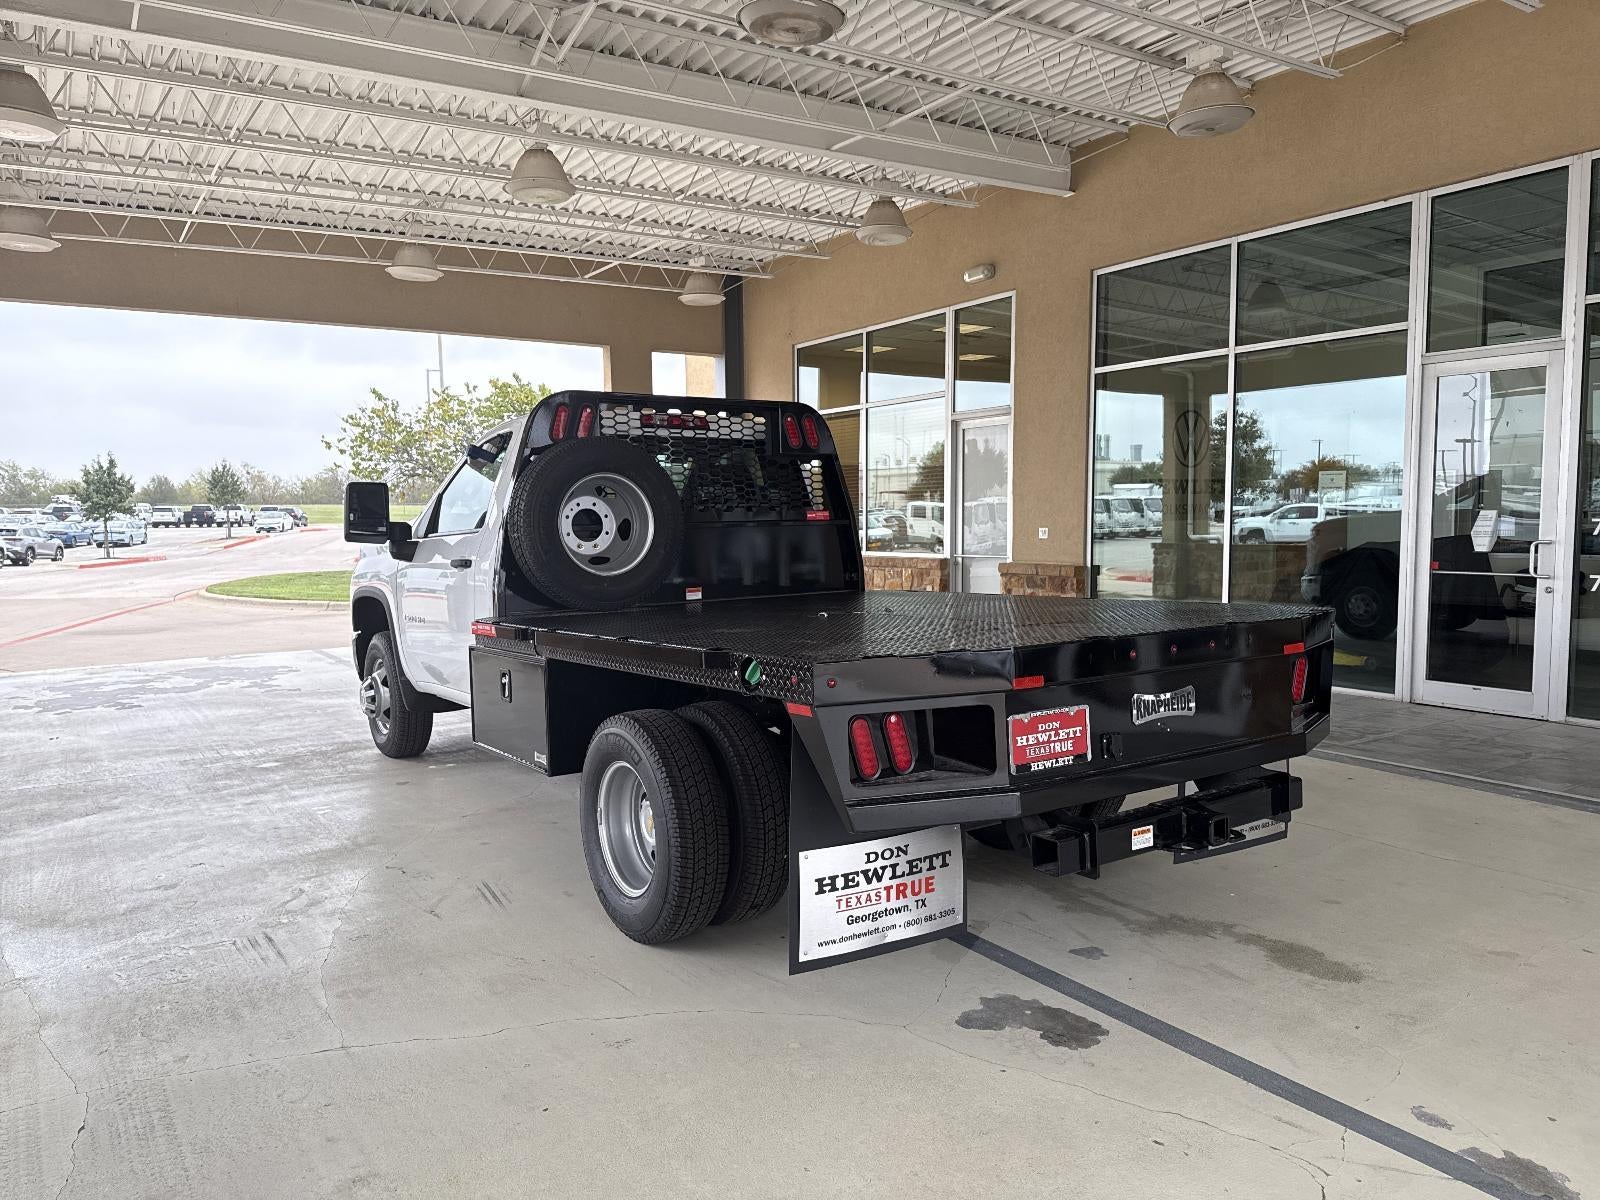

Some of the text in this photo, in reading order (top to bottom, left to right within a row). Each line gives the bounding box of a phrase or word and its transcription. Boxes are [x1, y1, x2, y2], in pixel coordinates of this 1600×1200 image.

[1135, 690, 1193, 720] KNAPHEIDE
[1015, 727, 1083, 747] HEWLETT
[1037, 721, 1061, 732] DON
[1030, 755, 1074, 772] HEWLETT
[864, 843, 910, 865] DON
[814, 850, 952, 896] HEWLETT
[846, 897, 927, 926] Georgetown, TX
[817, 907, 956, 948] www.donhewlett.com (800) 681-3305
